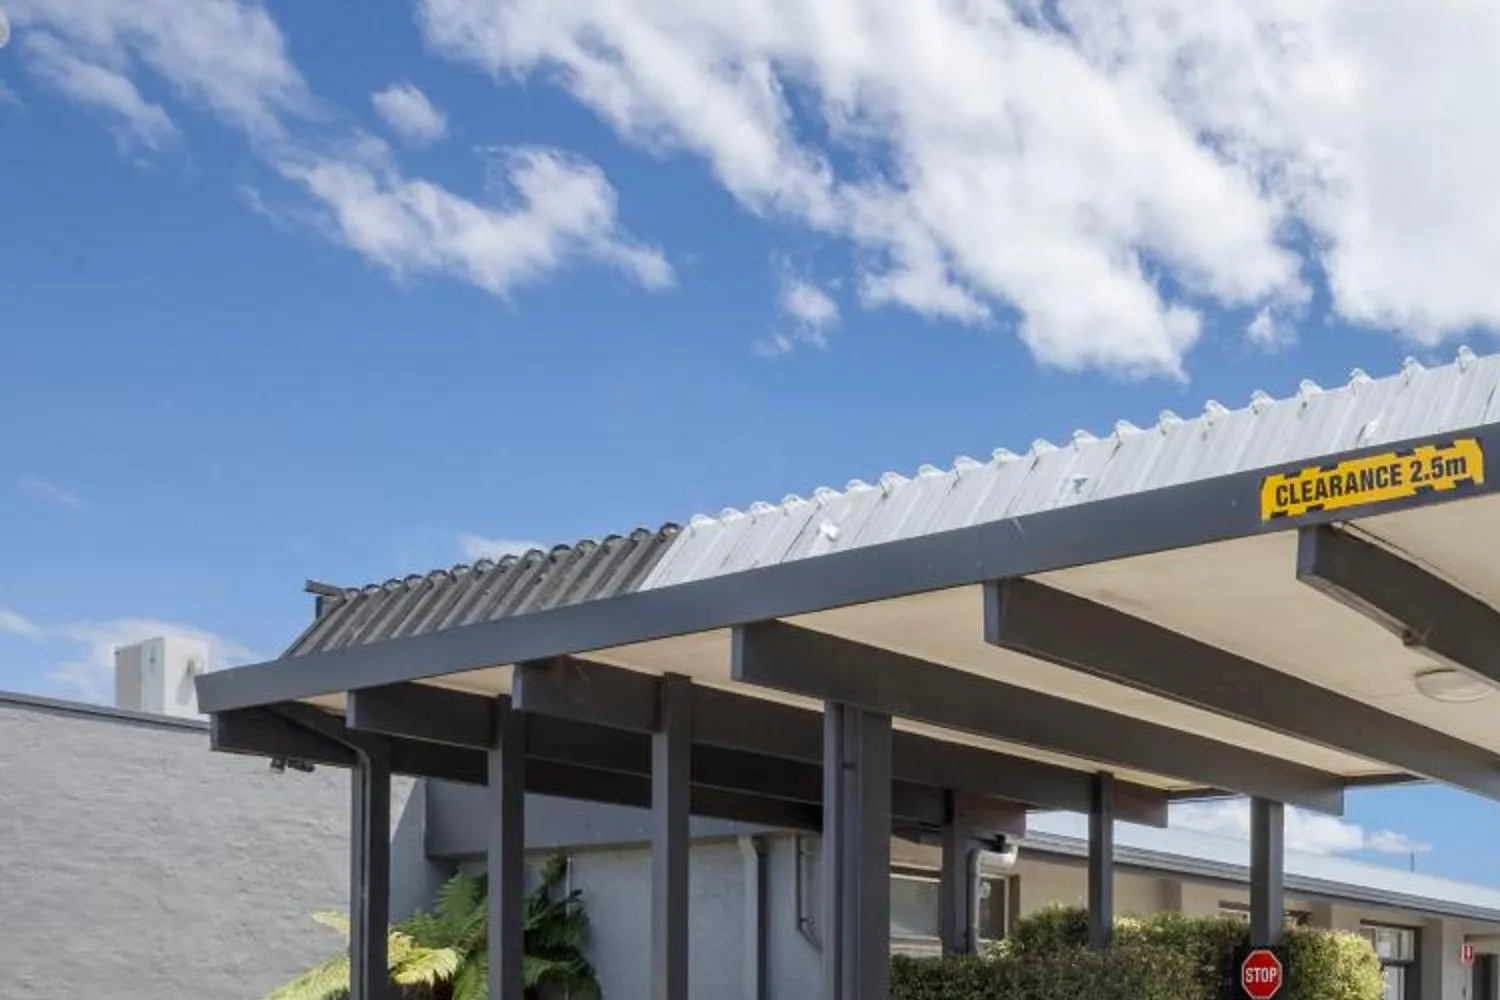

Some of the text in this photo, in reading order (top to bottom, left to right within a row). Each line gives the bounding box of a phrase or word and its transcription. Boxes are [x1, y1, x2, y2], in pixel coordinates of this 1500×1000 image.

[1275, 455, 1467, 507] CLEARANCE 2.5m
[1245, 967, 1278, 983] STOP
